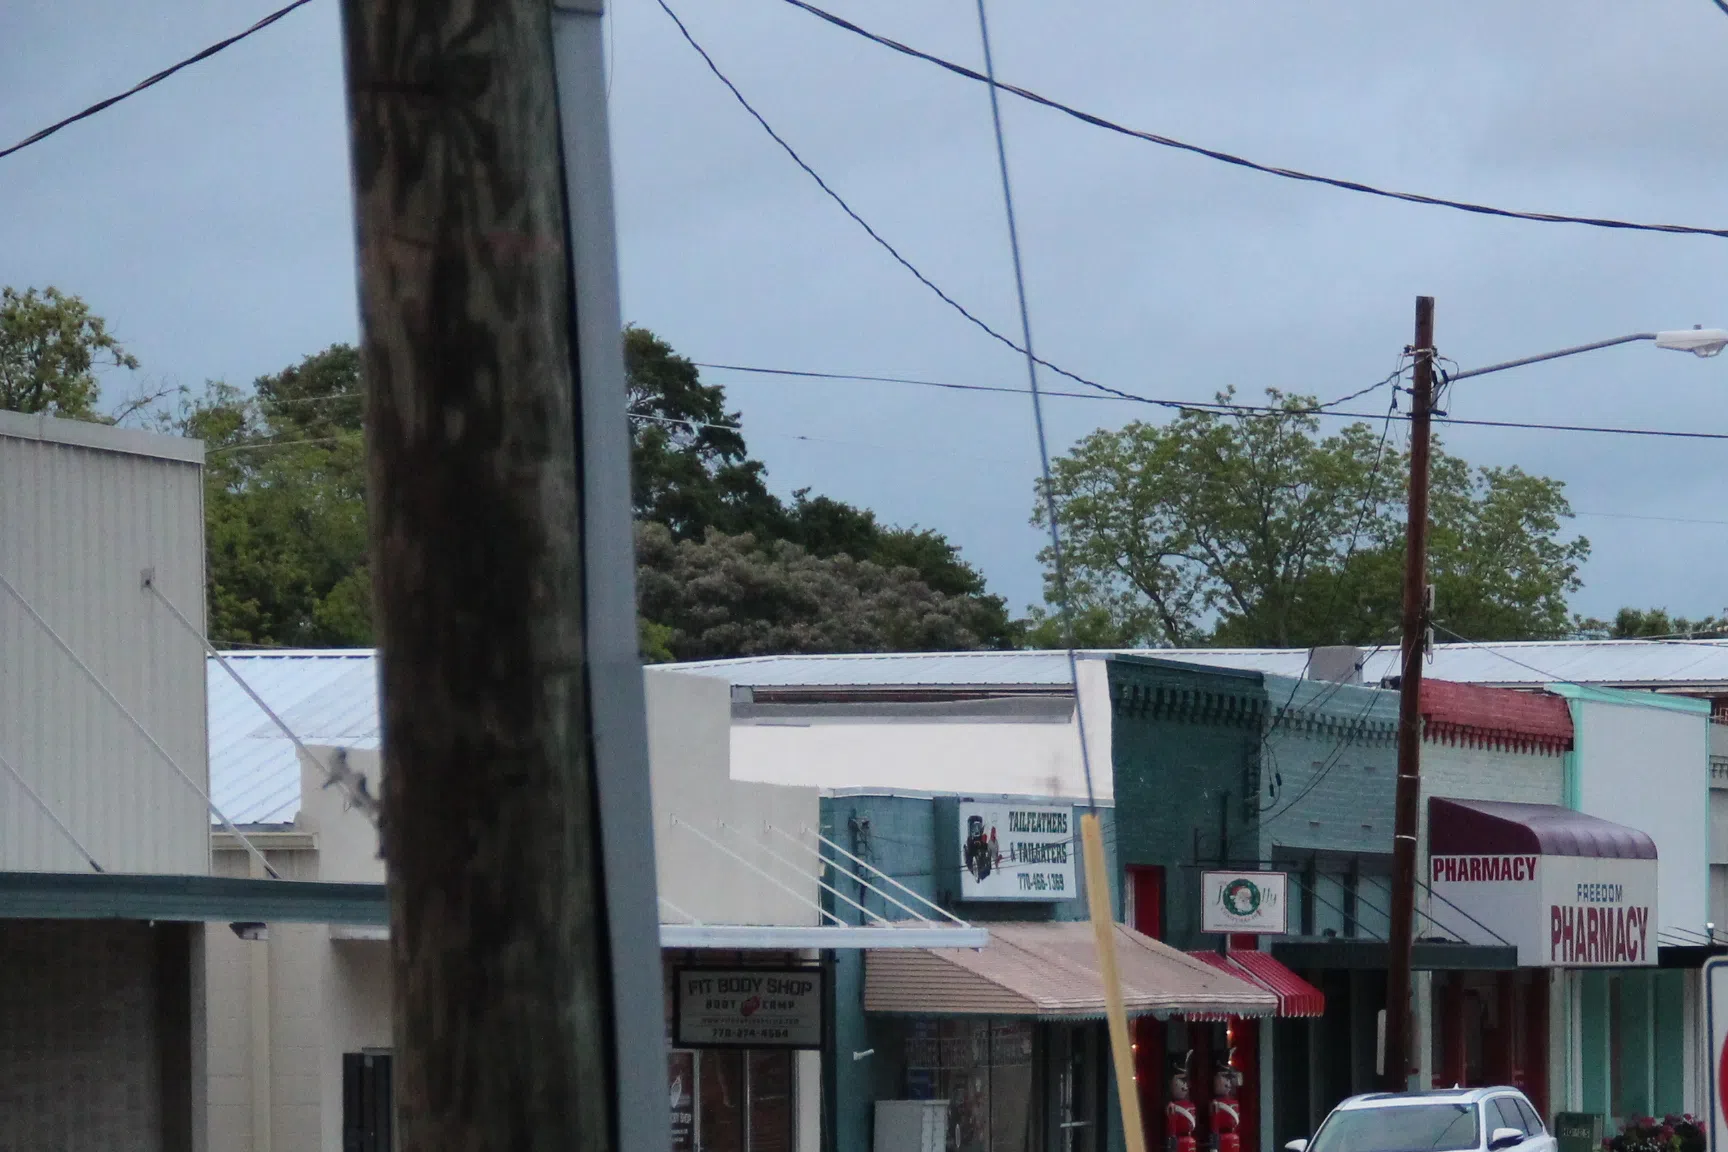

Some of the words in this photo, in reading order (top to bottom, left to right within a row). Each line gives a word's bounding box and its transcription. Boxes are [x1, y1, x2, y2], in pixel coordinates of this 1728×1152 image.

[1008, 811, 1068, 834] TAILFEATHERS
[1018, 842, 1067, 864] TAILGATERS
[1432, 856, 1537, 882] PHARMACY
[1017, 872, 1065, 891] 770-466-1369
[1577, 883, 1623, 902] FREEDOM
[1550, 905, 1649, 963] PHARMACY
[688, 979, 715, 996] FIT
[717, 977, 764, 994] BODY
[766, 978, 813, 997] SHOP
[762, 1000, 796, 1010] CAMP
